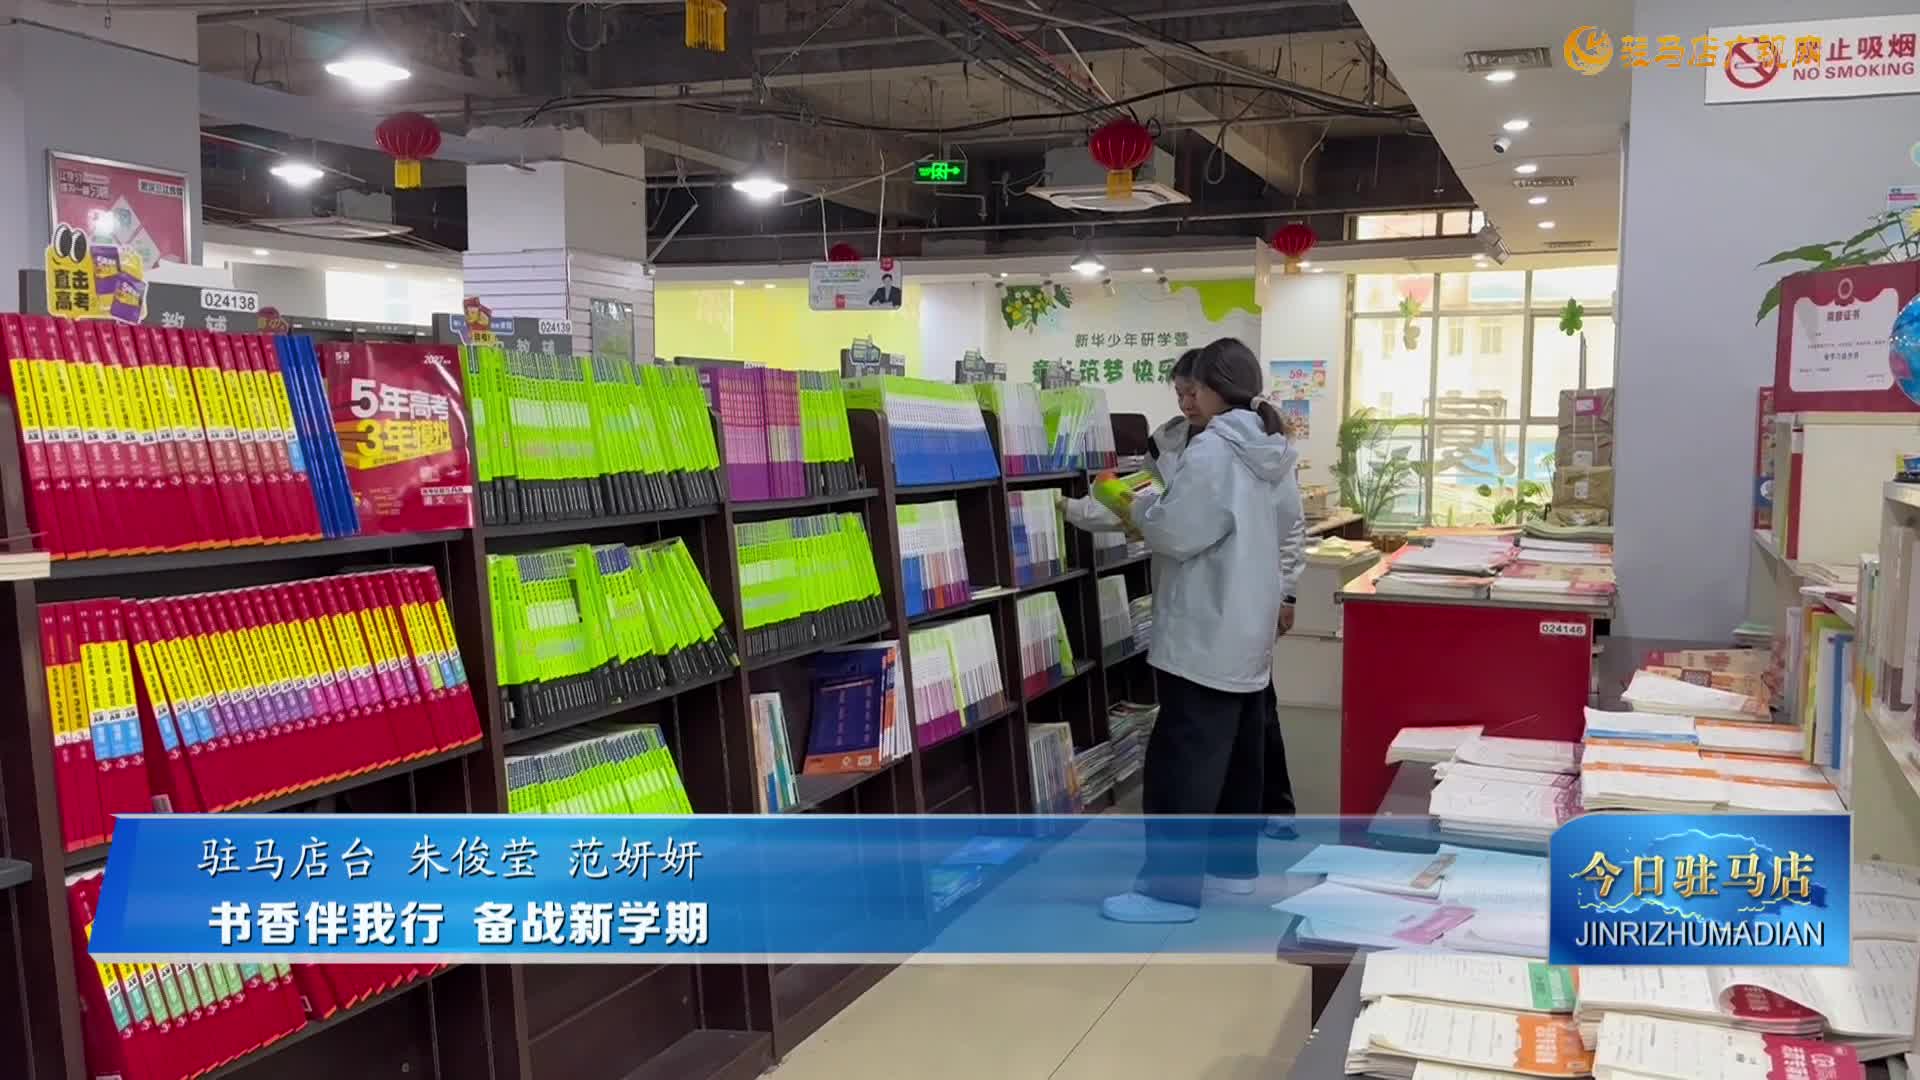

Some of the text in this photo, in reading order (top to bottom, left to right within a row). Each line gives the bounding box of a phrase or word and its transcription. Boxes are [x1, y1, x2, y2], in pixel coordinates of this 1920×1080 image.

[1797, 33, 1917, 62] 止吸烟
[1793, 61, 1916, 81] NO SMOKING
[54, 269, 89, 290] 直击
[55, 291, 90, 311] 高考
[204, 292, 256, 311] 024138
[540, 321, 571, 334] 024139
[1032, 358, 1124, 384] 童筑梦
[351, 378, 449, 419] 5年高考
[1541, 623, 1585, 635] 024146
